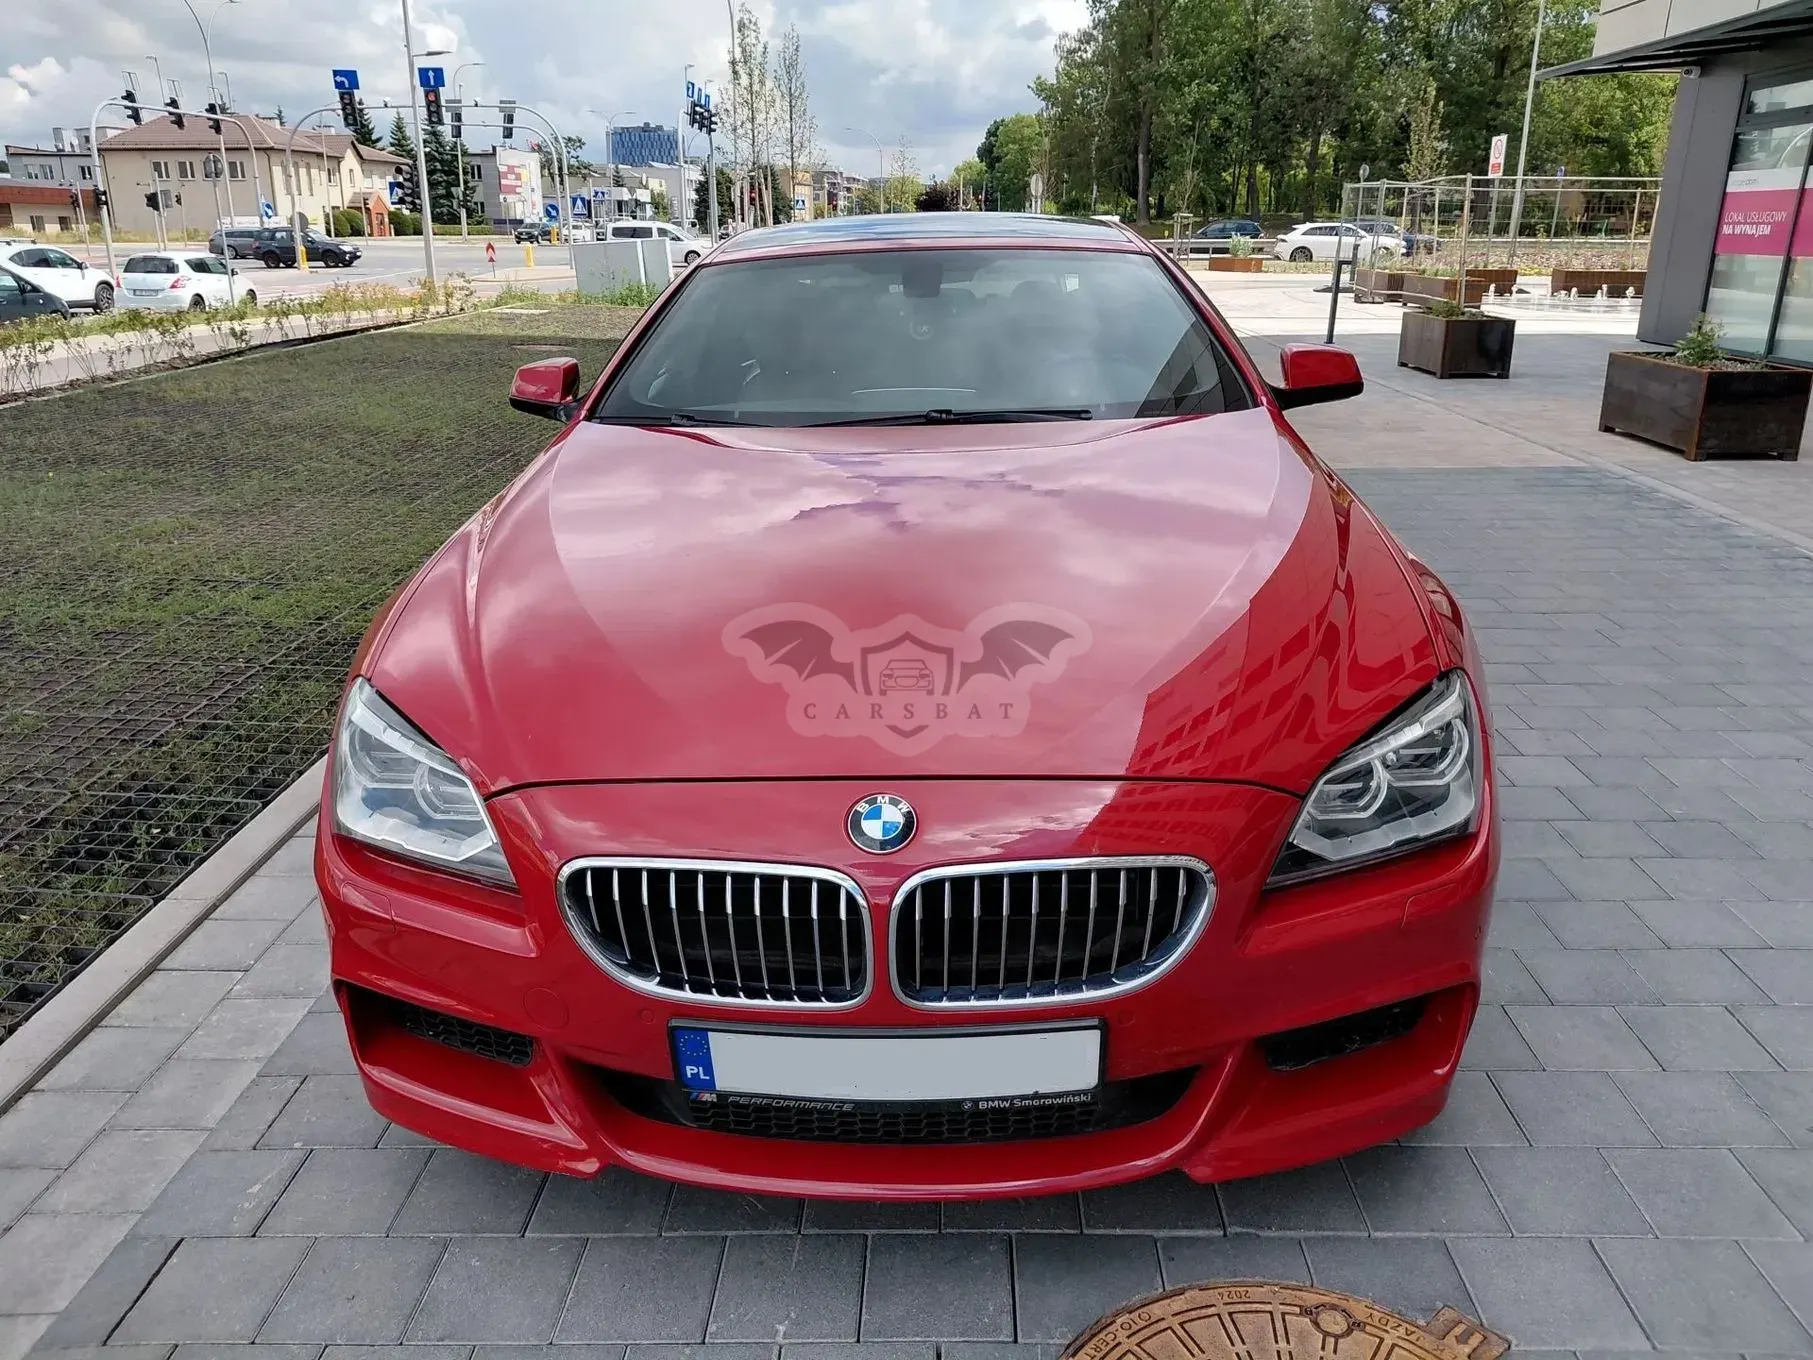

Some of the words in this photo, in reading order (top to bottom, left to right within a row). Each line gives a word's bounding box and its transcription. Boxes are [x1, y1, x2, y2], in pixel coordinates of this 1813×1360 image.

[1725, 211, 1745, 222] LOKAL
[1722, 224, 1733, 234] NA
[1734, 224, 1771, 237] WYNAJEM
[856, 795, 910, 814] BMW
[686, 1065, 710, 1080] PL
[728, 1096, 855, 1112] PERFORMANCE
[979, 1100, 1010, 1110] BMW
[1216, 1290, 1251, 1301] 2024
[1364, 1312, 1426, 1343] JAZDY
